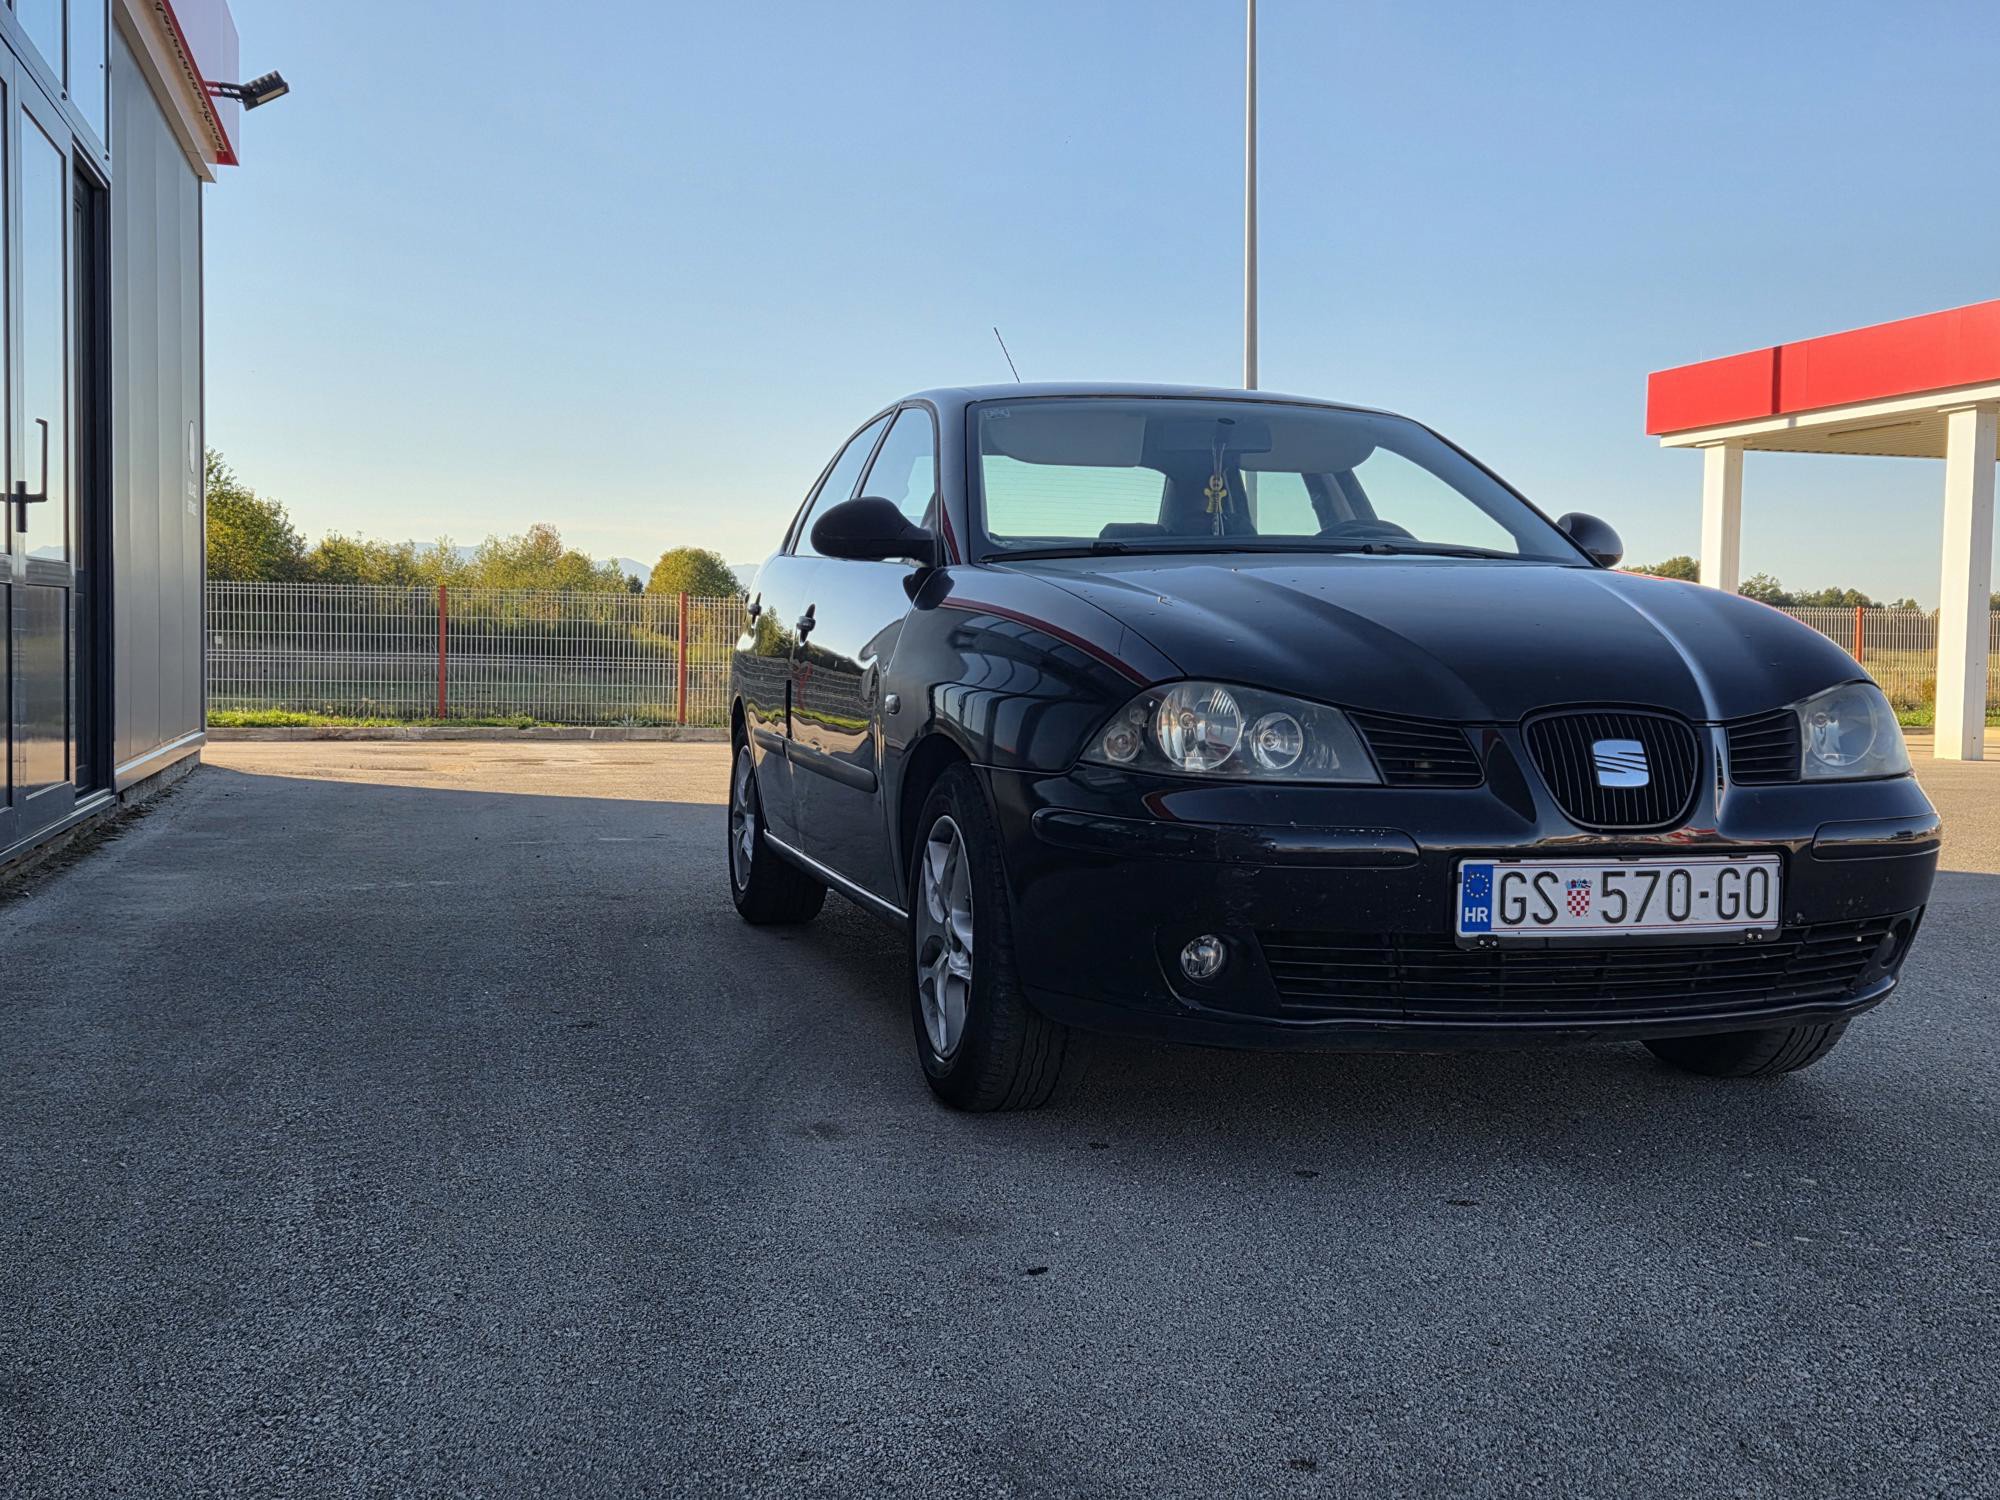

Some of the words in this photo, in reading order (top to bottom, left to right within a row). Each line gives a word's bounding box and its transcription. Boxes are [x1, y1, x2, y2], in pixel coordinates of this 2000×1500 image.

[1464, 906, 1488, 923] HR
[1500, 870, 1560, 925] GS
[1601, 866, 1770, 924] 570-GO
